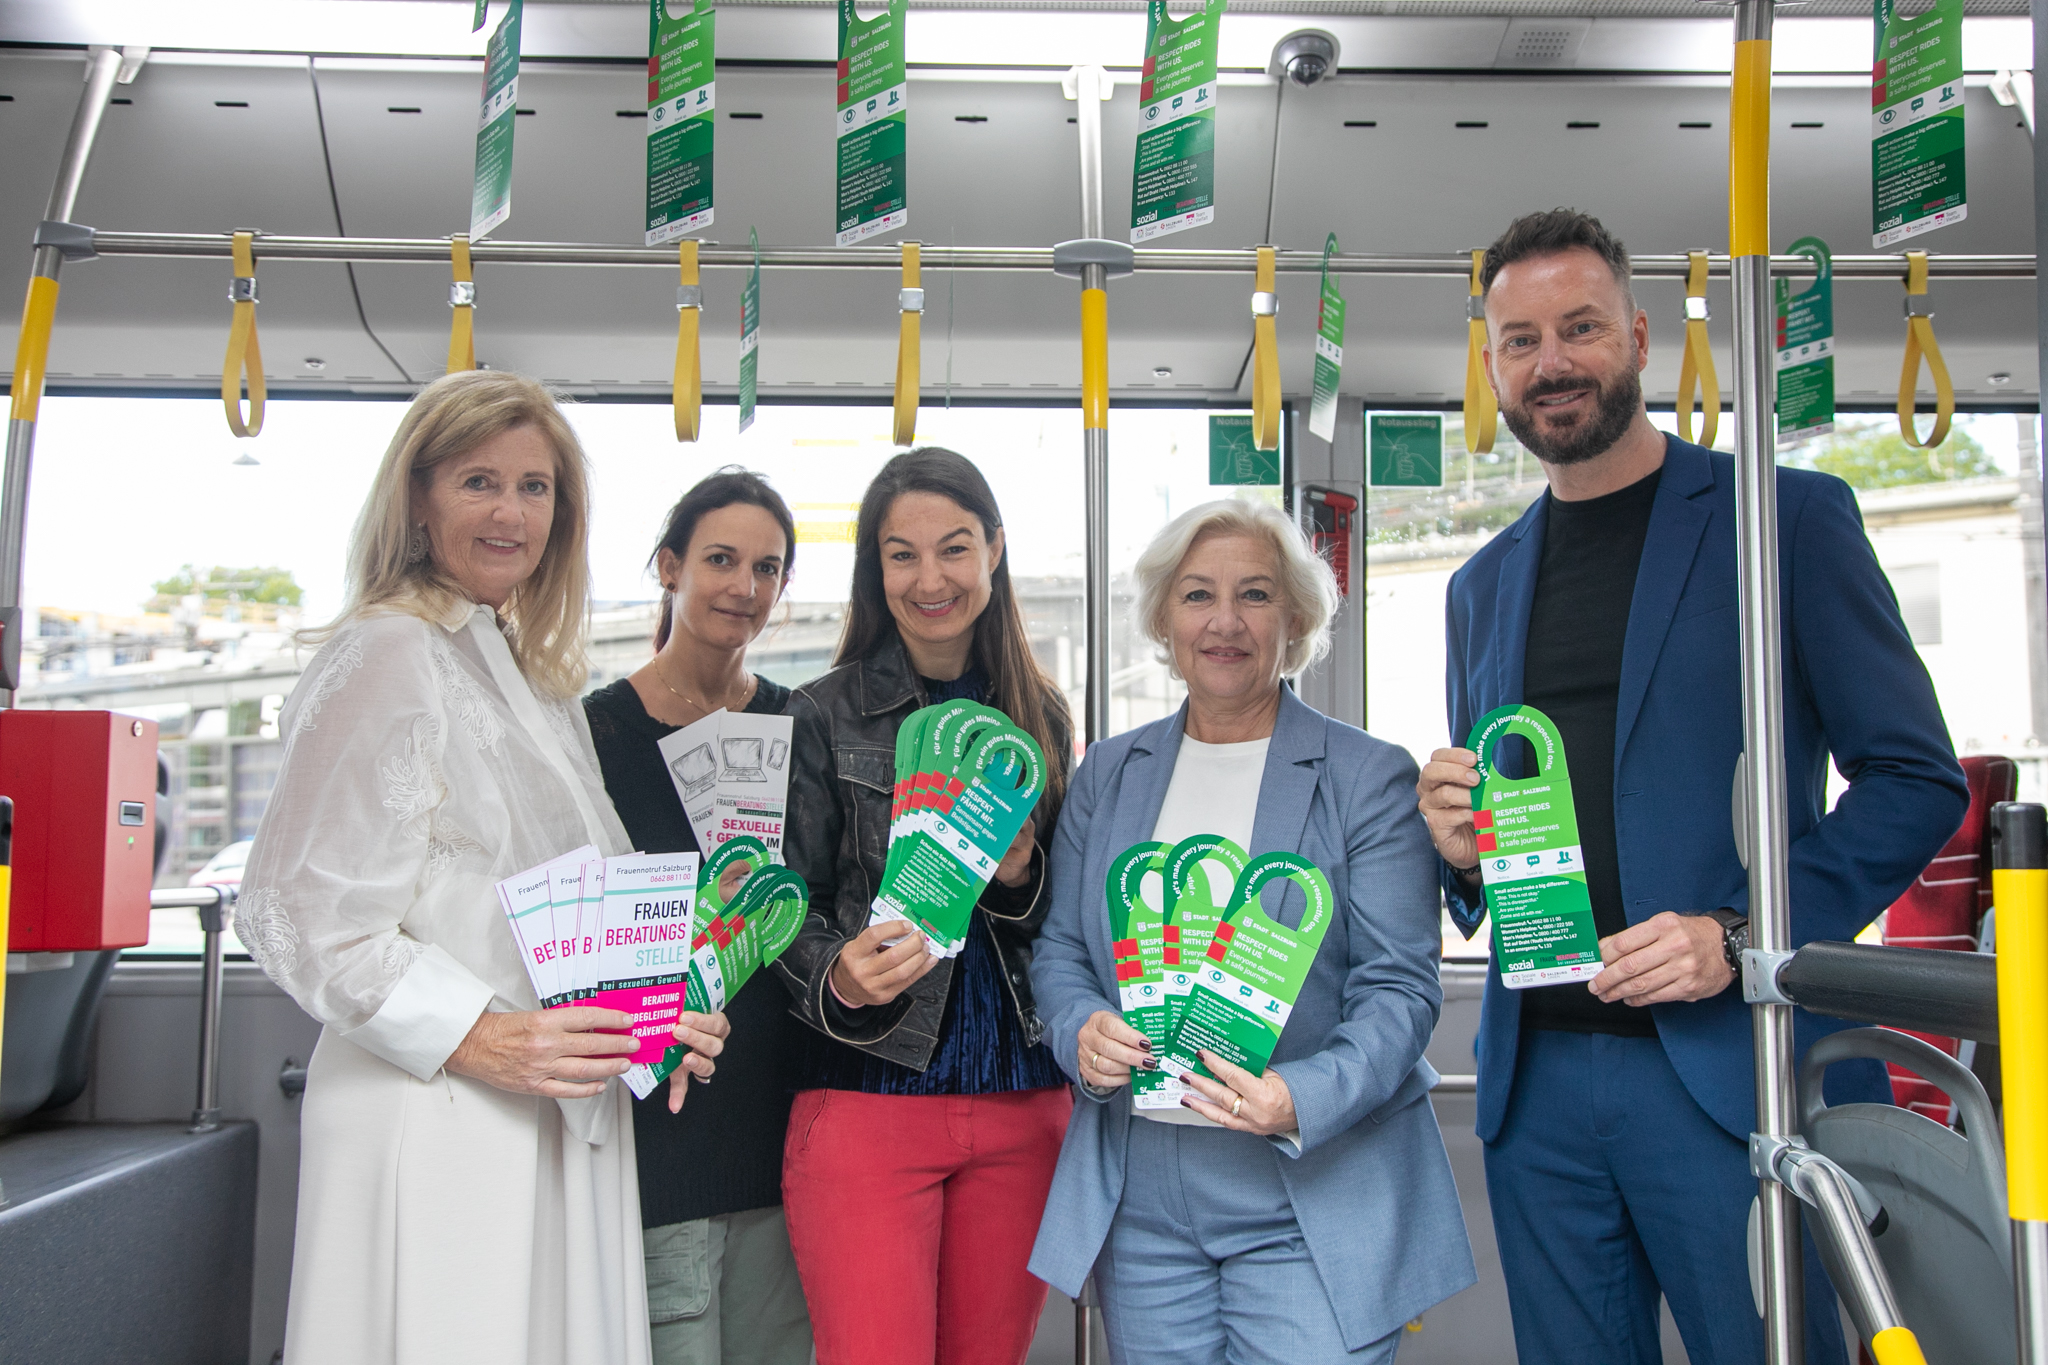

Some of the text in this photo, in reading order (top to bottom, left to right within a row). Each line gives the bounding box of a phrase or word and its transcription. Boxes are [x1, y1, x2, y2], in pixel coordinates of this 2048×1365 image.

[1183, 21, 1205, 34] SALZBURG
[1899, 18, 1943, 42] STADT SALZBURG
[661, 39, 699, 62] RESPECT RIDES
[851, 40, 889, 64] RESPECT RIDES
[1158, 38, 1201, 62] RESPECT RIDES
[1890, 37, 1940, 64] RESPECT RIDES
[661, 61, 673, 71] WITH
[661, 61, 702, 84] Everyone deserves
[851, 63, 864, 73] WITH
[851, 62, 893, 86] Everyone deserves
[1157, 61, 1172, 71] WITH
[1157, 60, 1204, 84] Everyone deserves
[1889, 57, 1919, 74] WITH US.
[1890, 58, 1946, 87] Everyone deserves
[665, 84, 673, 93] safe
[854, 86, 864, 95] safe
[1160, 82, 1170, 92] safe
[1894, 75, 1932, 95] safe journey.
[651, 213, 667, 228] sozial
[841, 214, 858, 230] sozial
[1137, 210, 1157, 225] sozial
[1879, 214, 1902, 231] sozial
[1216, 416, 1252, 426] Notaus
[1377, 417, 1436, 429] Notausstieg
[937, 713, 952, 730] gutes
[959, 718, 975, 734] gutes
[1496, 714, 1524, 726] journey
[1482, 722, 1498, 739] every
[1531, 720, 1554, 753] respectful
[980, 746, 988, 757] ein
[986, 735, 1004, 748] gutes
[1004, 734, 1037, 764] Miteinander
[1476, 740, 1485, 761] make
[1478, 762, 1490, 781] Let's
[1545, 755, 1553, 771] one.
[979, 784, 1012, 813] STADT SALZBURG
[1523, 786, 1550, 795] SALZBURG
[965, 788, 994, 813] RESPEKT
[960, 795, 993, 826] FÄHRT MIT.
[1495, 802, 1550, 817] RESPECT RIDES
[722, 819, 781, 834] SEXUELLE
[955, 805, 997, 842] Gemeinsam gegen
[1497, 817, 1515, 826] WITH
[1498, 824, 1559, 839] Everyone deserves
[766, 837, 779, 848] IM
[1198, 843, 1225, 854] journey
[1506, 838, 1519, 846] safe
[1521, 836, 1547, 845] journey.
[716, 851, 731, 866] make
[731, 845, 747, 853] every
[1180, 845, 1197, 860] every
[617, 866, 661, 874] Frauennotruf
[1173, 860, 1182, 880] make
[1264, 862, 1284, 870] every
[1285, 861, 1311, 879] journey
[1120, 851, 1165, 911] Let's make every journey
[1249, 868, 1264, 885] make
[1173, 882, 1183, 899] Let's
[634, 900, 688, 921] FRAUEN
[884, 894, 906, 912] sozial
[1313, 885, 1323, 923] respectful
[605, 923, 686, 946] BERATUNGS
[1183, 929, 1214, 937] RESPECT
[1253, 923, 1297, 948] STADT SALZBURG
[1302, 922, 1315, 933] one.
[1183, 938, 1201, 946] WITH
[1234, 940, 1262, 959] WITH US.
[1237, 932, 1288, 962] RESPECT RIDES
[635, 946, 684, 967] STELLE
[1508, 959, 1534, 971] sozial
[1229, 950, 1285, 982] Everyone deserves
[1230, 961, 1243, 971] safe
[1243, 968, 1268, 984] journey.
[602, 975, 682, 991] bei sexueller Gewalt
[642, 992, 680, 1006] BERATUNG
[1171, 1052, 1195, 1069] sozial
